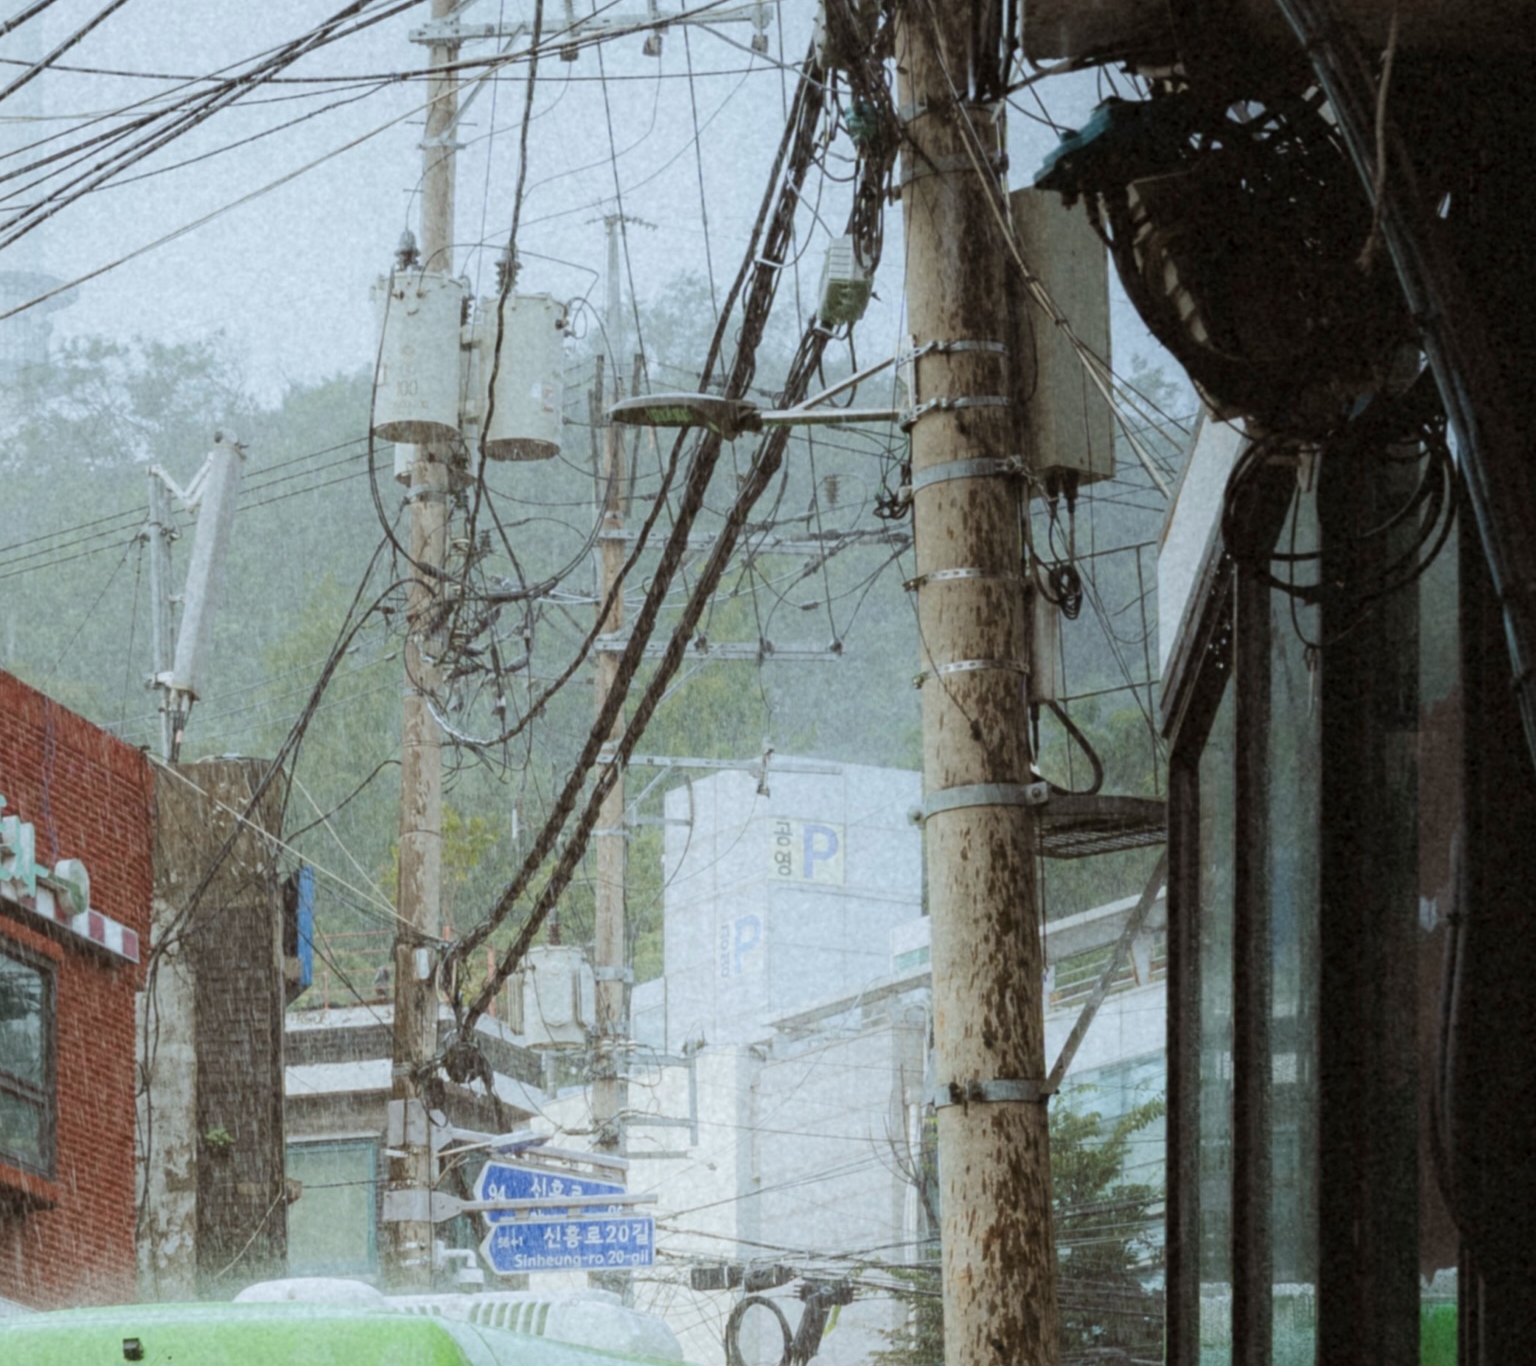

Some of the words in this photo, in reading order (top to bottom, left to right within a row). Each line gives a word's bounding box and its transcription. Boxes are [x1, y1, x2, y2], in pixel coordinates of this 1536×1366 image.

[803, 824, 839, 879] P
[734, 913, 761, 974] P
[488, 1184, 506, 1201] 94
[543, 1222, 649, 1249] 신흥로20길
[515, 1253, 604, 1269] Sinheung-ro
[608, 1250, 649, 1266] 20-gil
